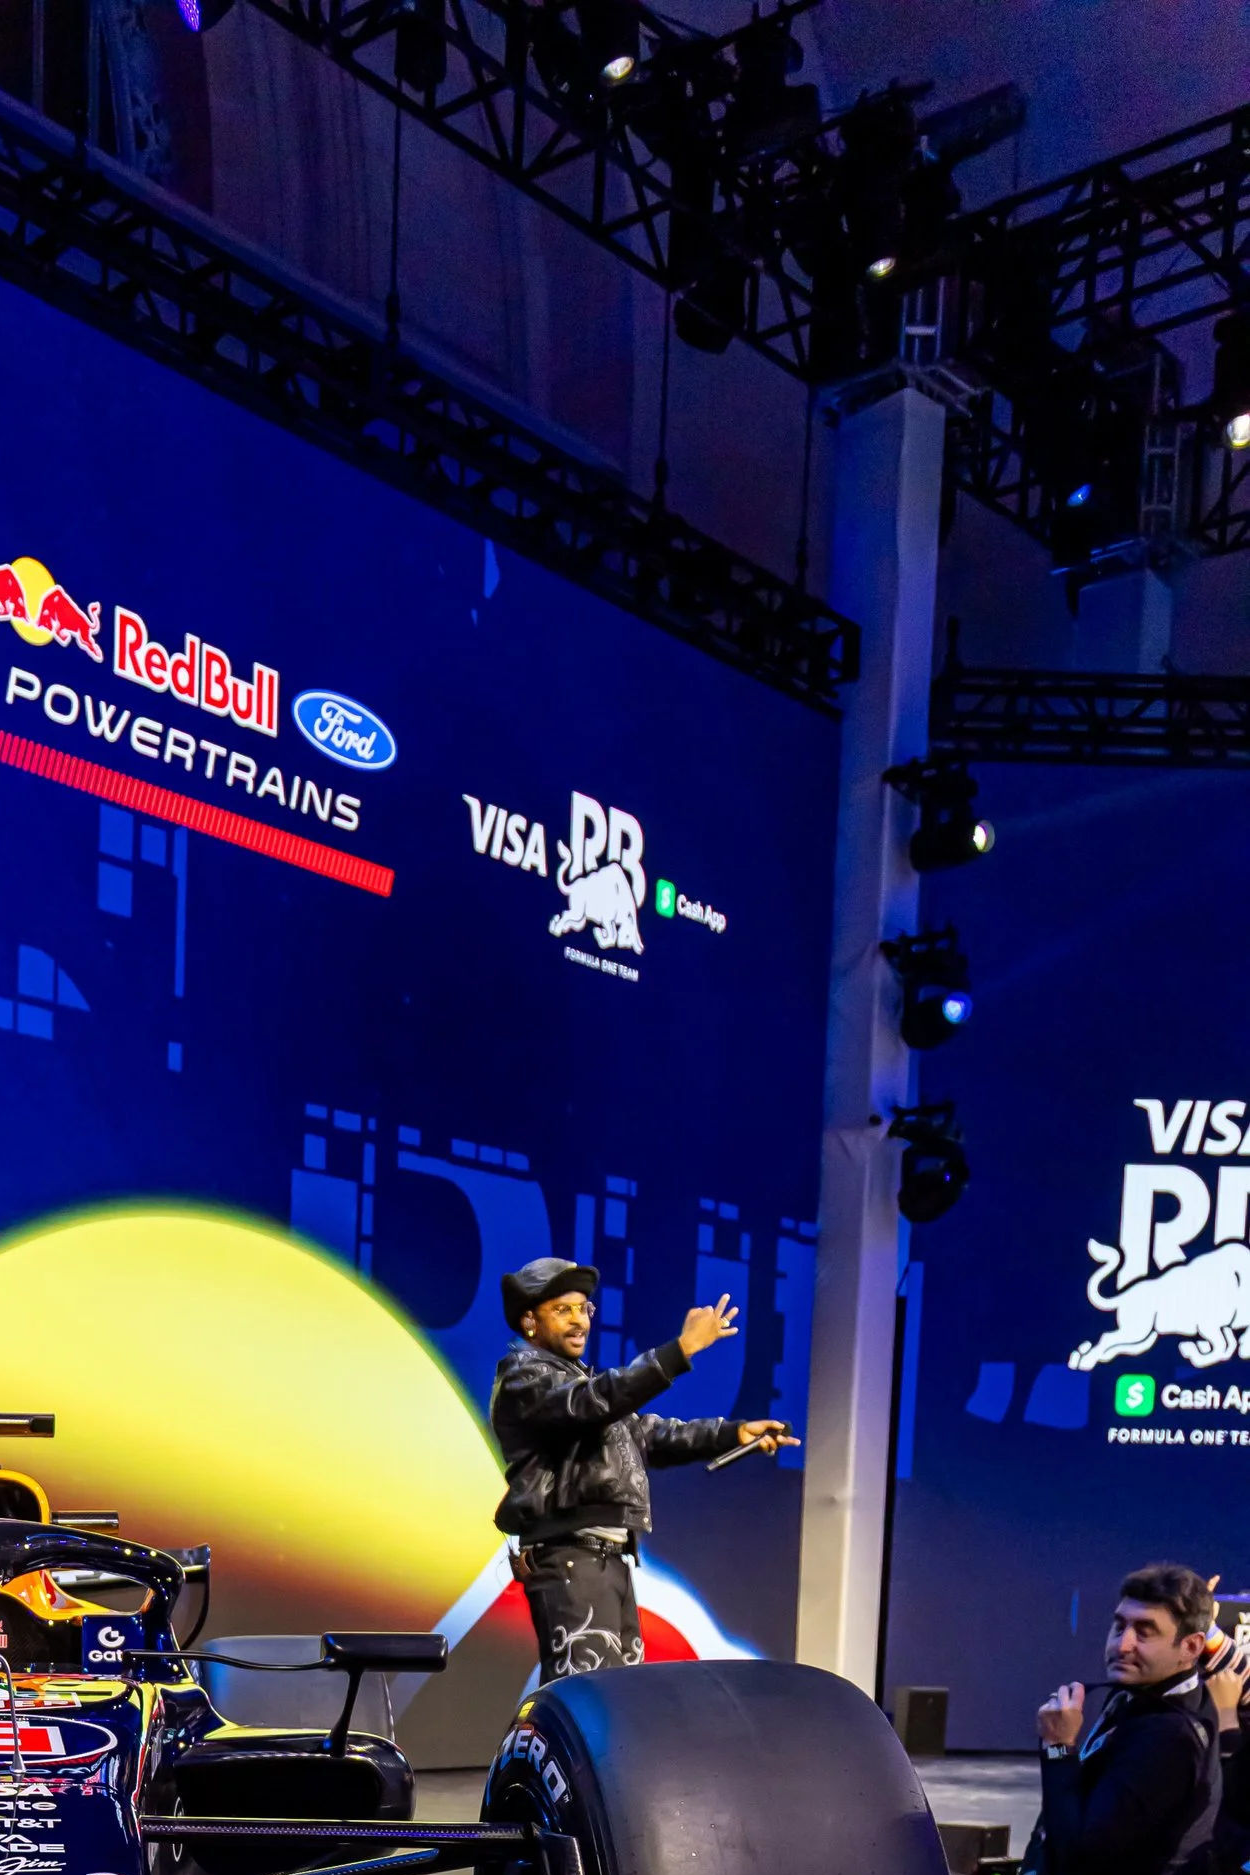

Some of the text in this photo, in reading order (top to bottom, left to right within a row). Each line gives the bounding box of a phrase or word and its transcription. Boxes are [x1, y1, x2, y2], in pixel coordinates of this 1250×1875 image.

[5, 667, 362, 831] POWERTRAINS
[313, 700, 378, 761] Ford
[462, 794, 548, 877] VISA
[677, 894, 704, 924] Cash
[704, 905, 727, 934] App
[564, 946, 639, 982] FORMULA ONE TEAM
[1161, 1383, 1221, 1409] Cash
[1108, 1428, 1250, 1445] FORMULA ONE TE
[88, 1650, 123, 1663] Gat
[500, 1729, 567, 1803] ZERO
